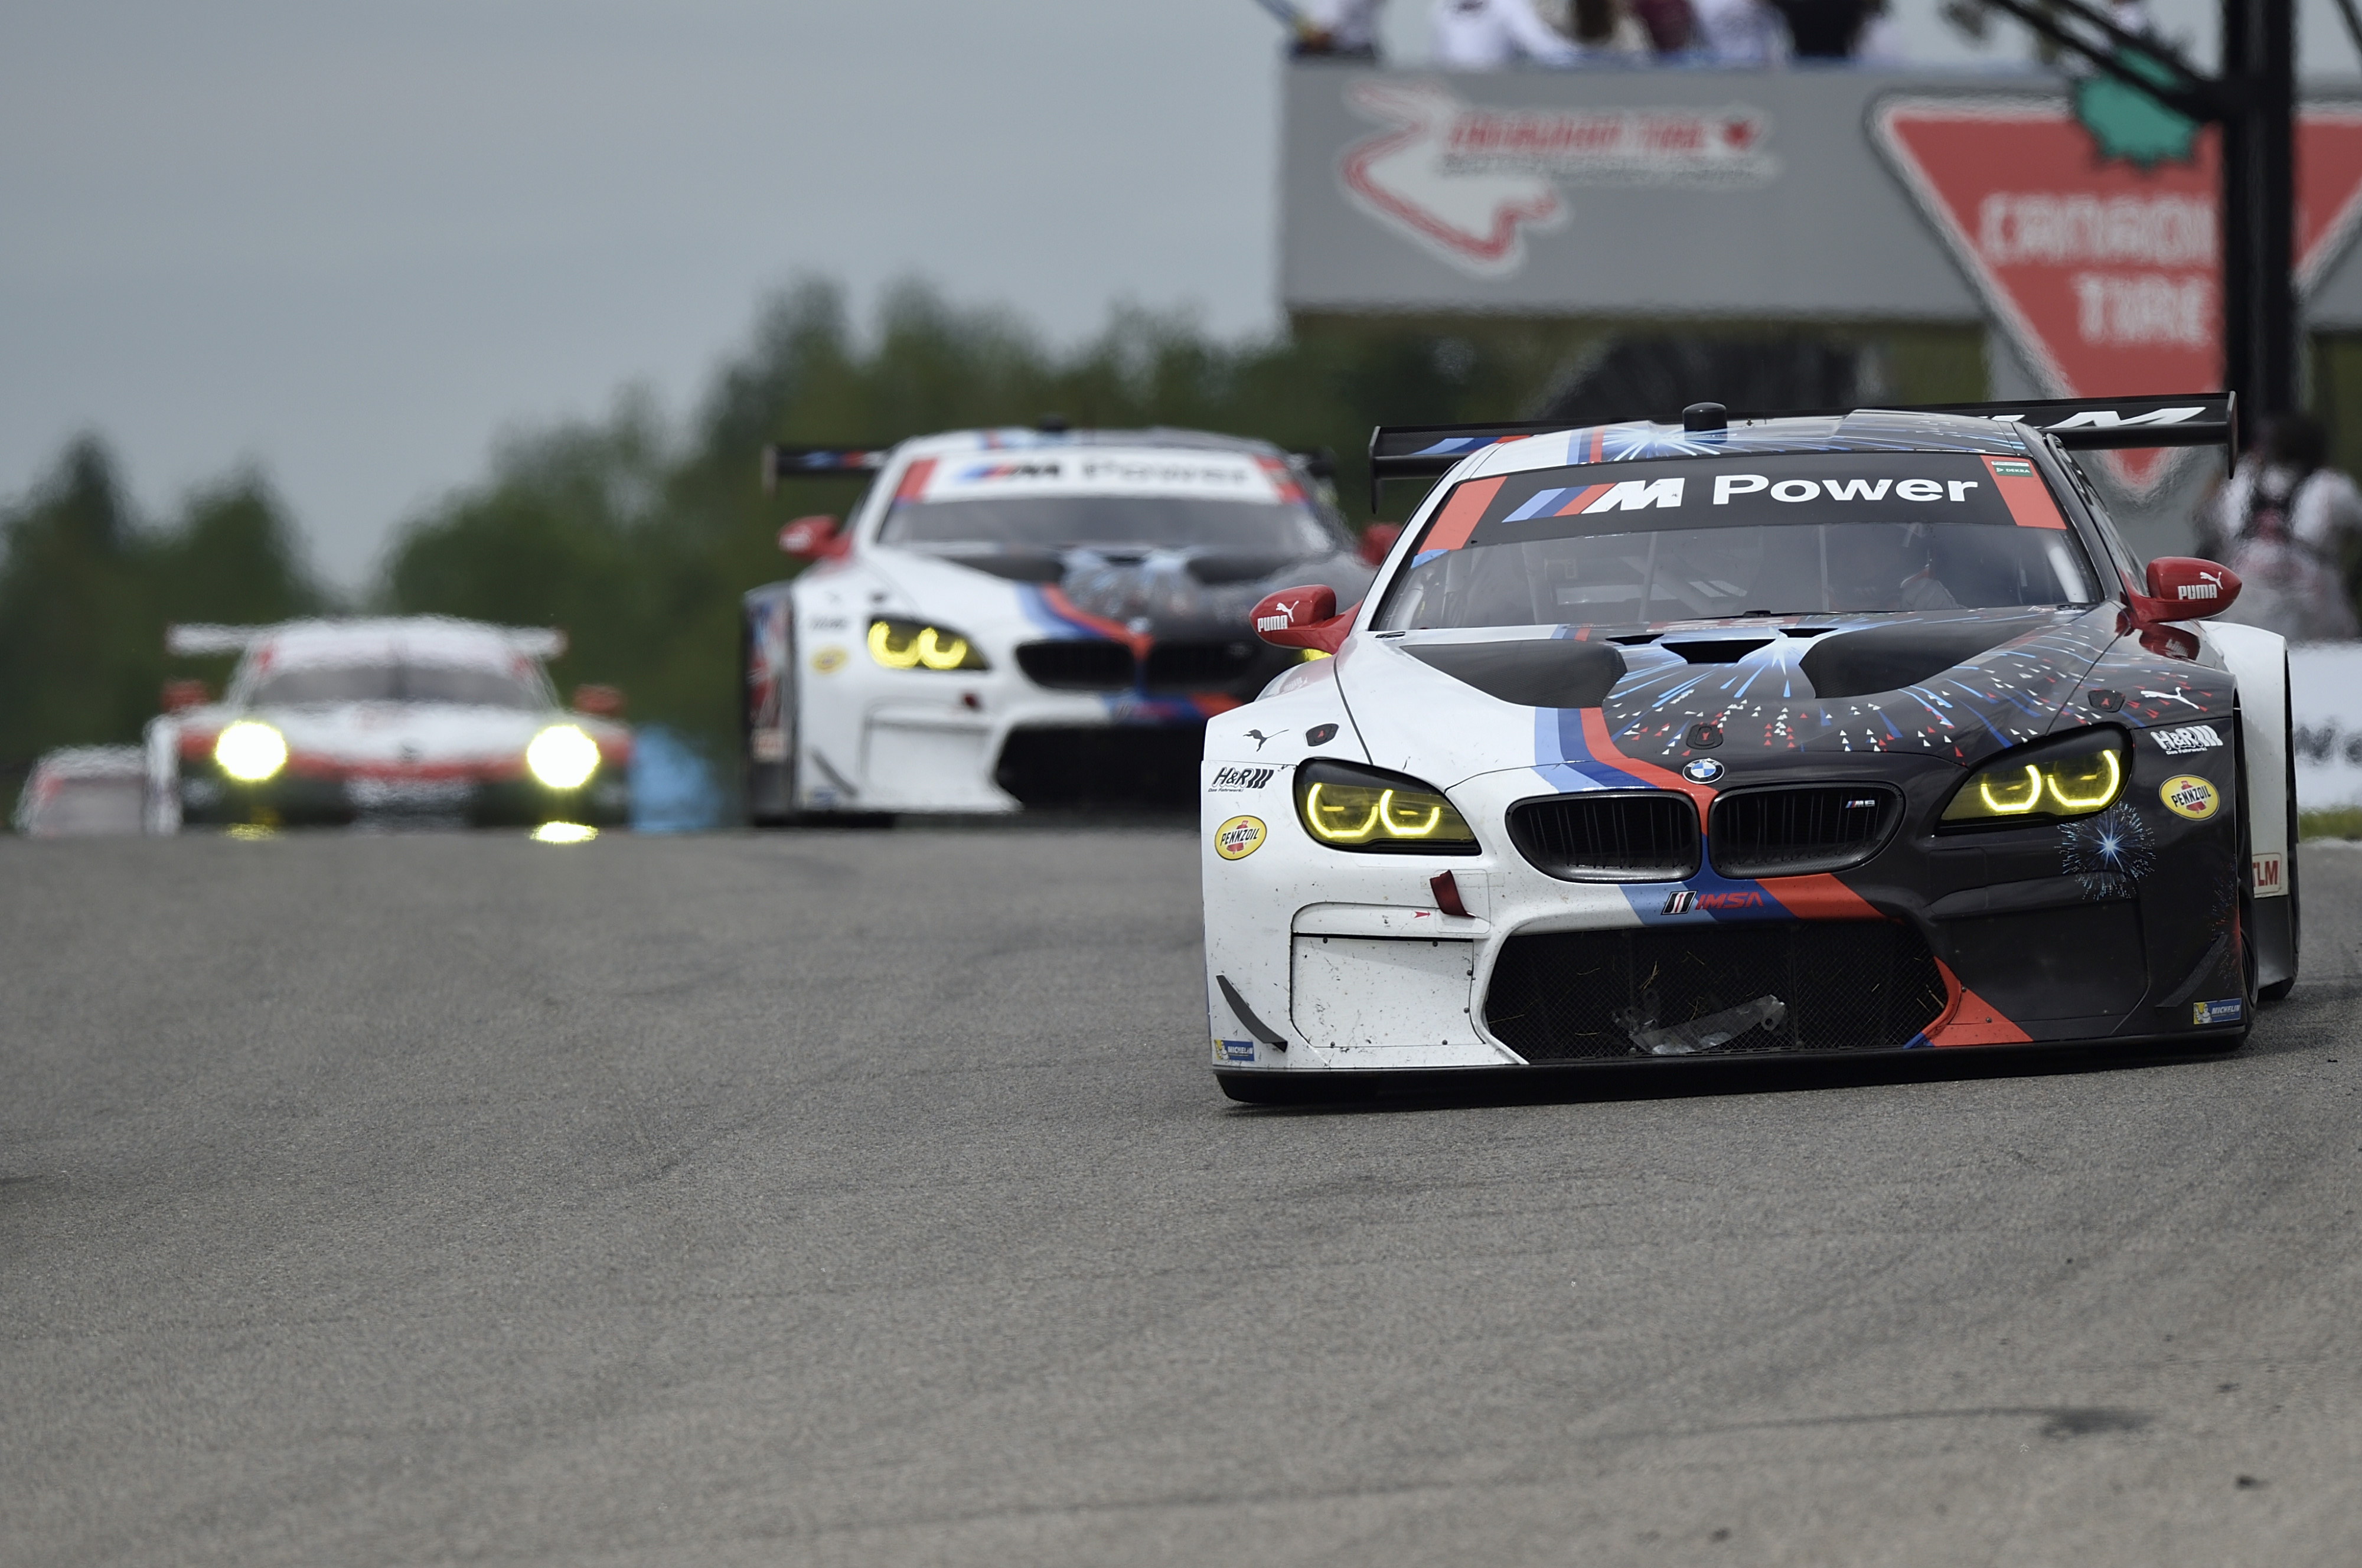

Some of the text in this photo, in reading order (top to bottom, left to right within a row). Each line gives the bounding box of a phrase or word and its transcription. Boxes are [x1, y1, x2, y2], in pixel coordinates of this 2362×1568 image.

[1978, 190, 2220, 266] CANADI
[1712, 474, 1979, 505] Power
[2178, 584, 2218, 600] PUMA
[1257, 615, 1288, 633] PUMA
[2171, 785, 2211, 808] PENNZOIL
[1219, 828, 1260, 847] PENNZOIL
[1695, 891, 1764, 910] IMSA
[2211, 1005, 2240, 1015] MICHELIN
